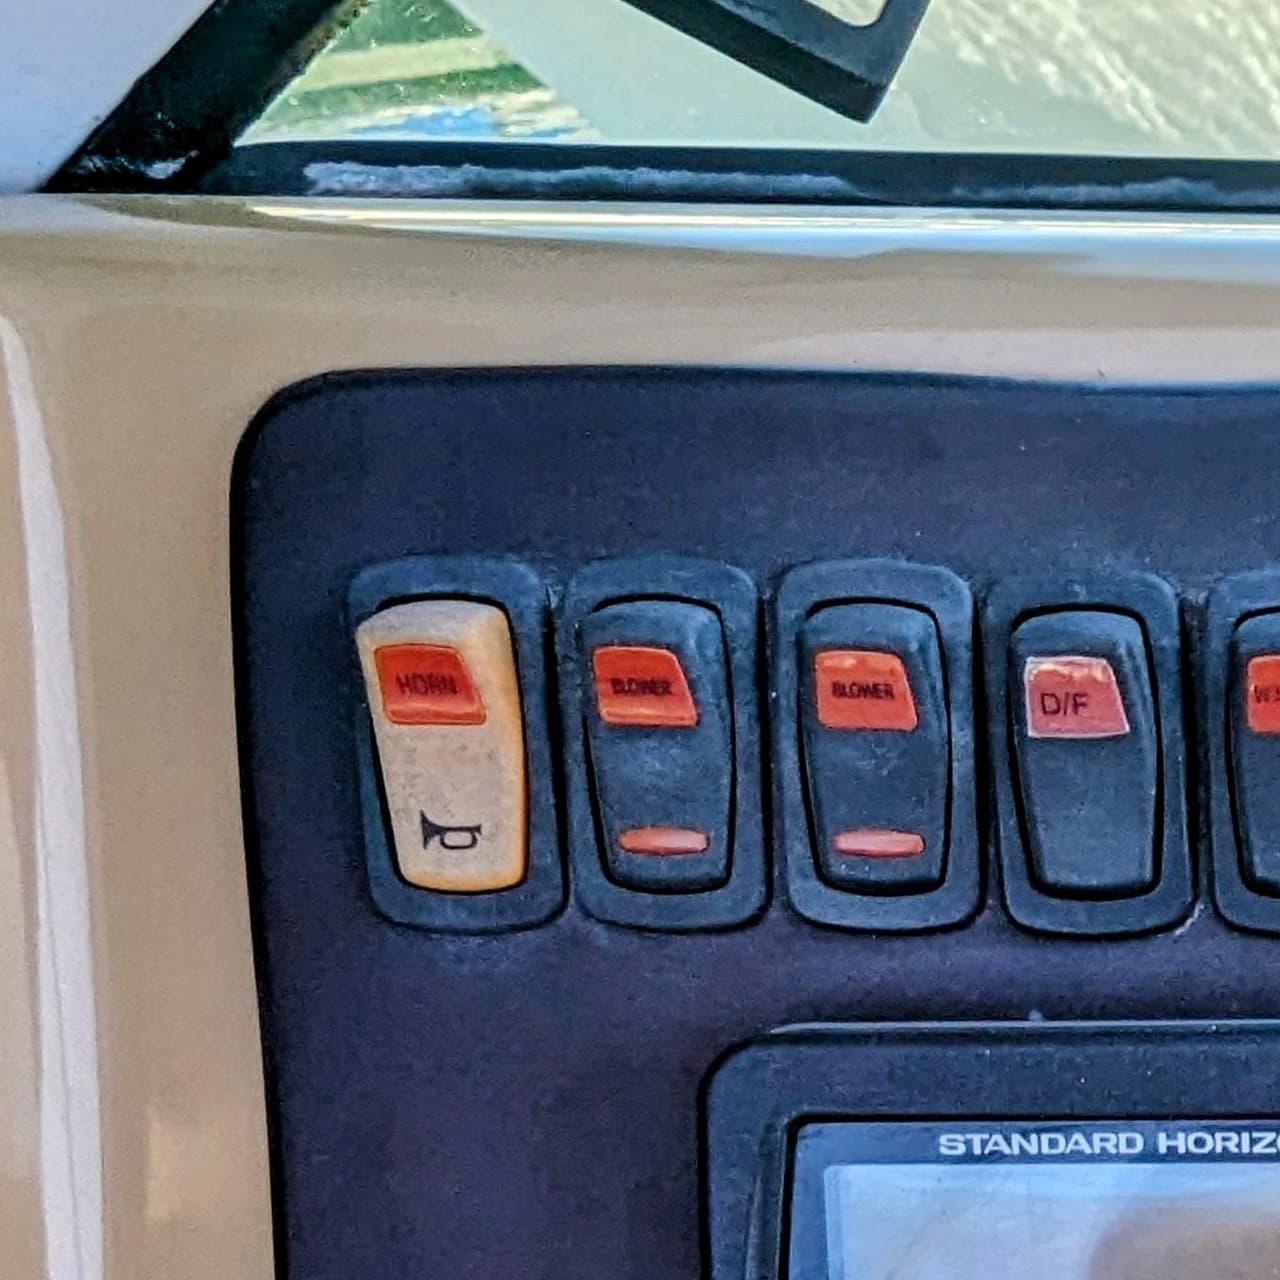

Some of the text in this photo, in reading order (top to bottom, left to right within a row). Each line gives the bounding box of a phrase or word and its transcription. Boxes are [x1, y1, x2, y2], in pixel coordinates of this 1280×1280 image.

[396, 672, 461, 695] HORN
[611, 677, 674, 697] BLOWER
[831, 680, 894, 700] BLOWER
[1040, 692, 1089, 716] D/F
[938, 1132, 1146, 1156] STANDARD
